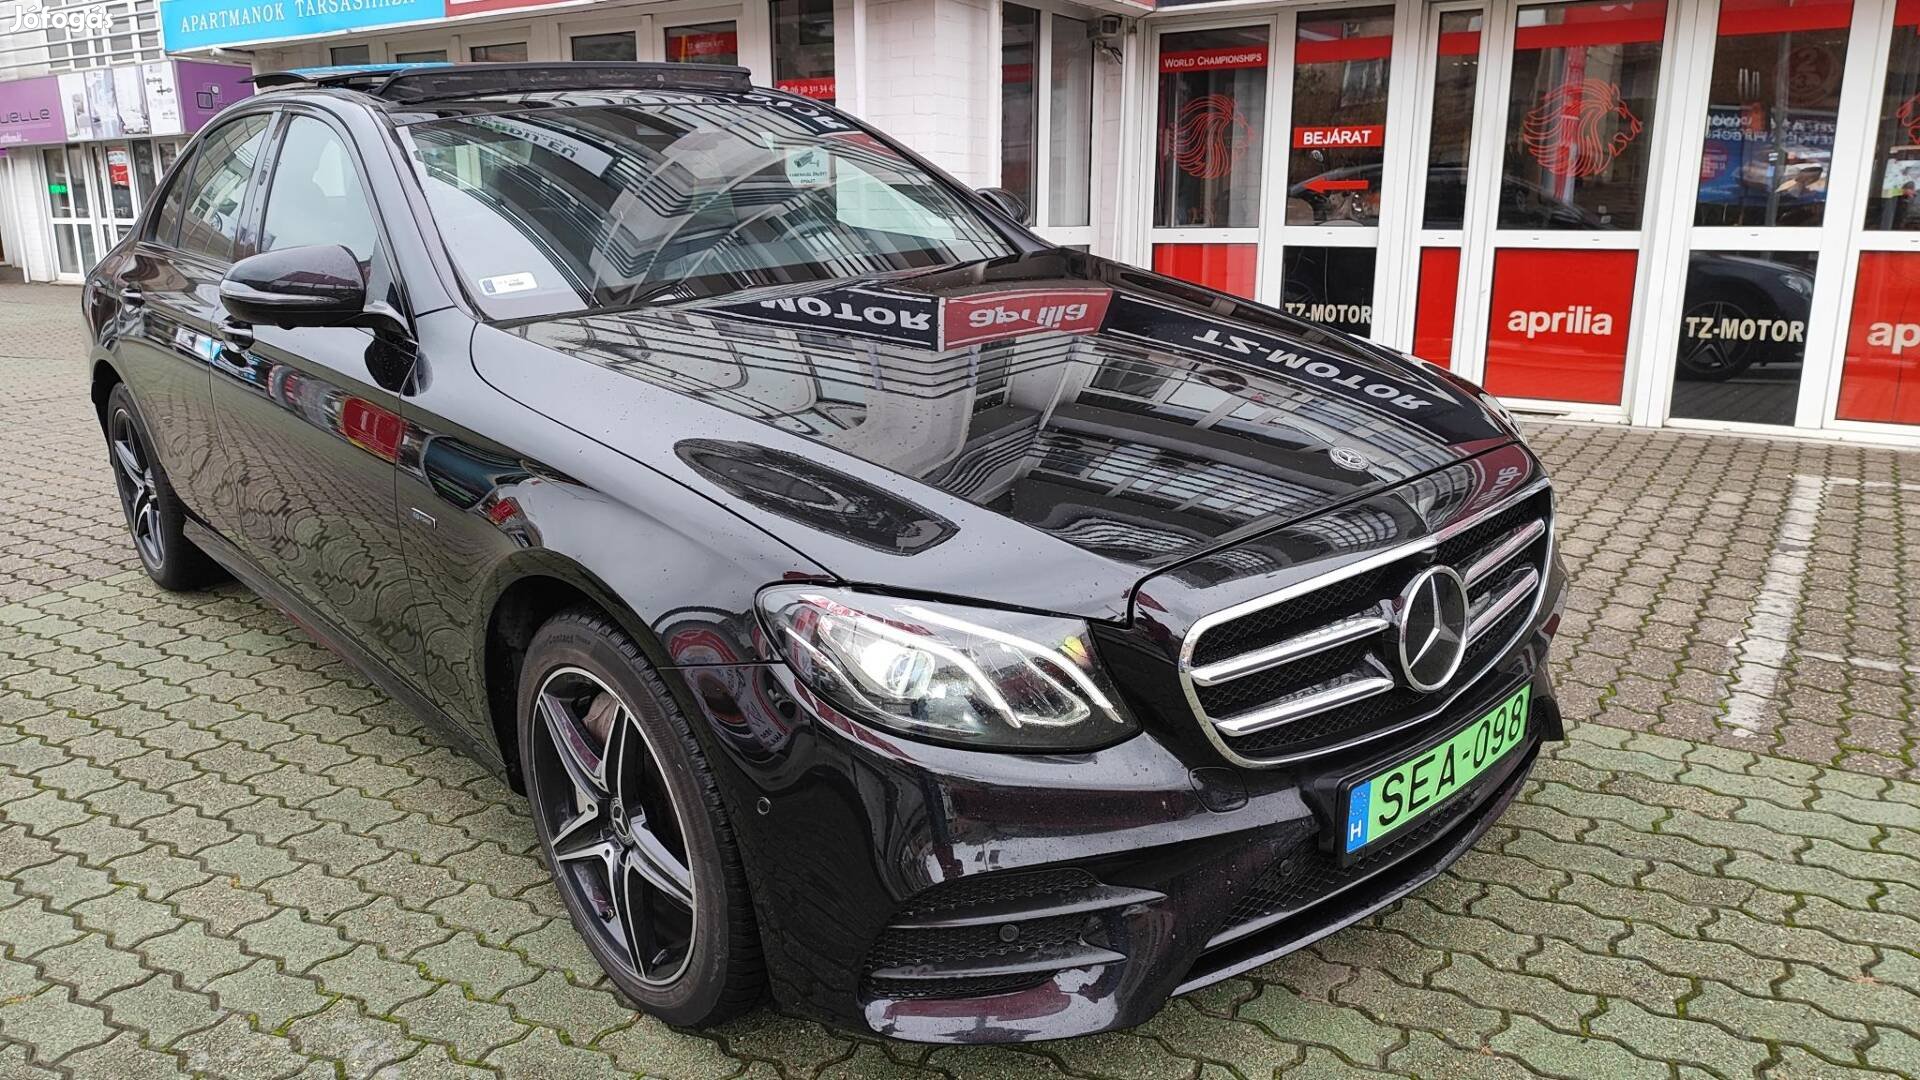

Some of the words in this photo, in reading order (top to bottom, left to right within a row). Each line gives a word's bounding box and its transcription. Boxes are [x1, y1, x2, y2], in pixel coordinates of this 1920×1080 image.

[181, 2, 285, 33] APARTMANOK
[1303, 128, 1372, 145] BEJÁRAT
[1285, 302, 1372, 324] TZ-MOTOR
[1507, 305, 1613, 339] aprilia
[1685, 317, 1805, 343] TZ-MOTOR
[1866, 321, 1920, 354] ap
[1379, 694, 1524, 826] SEA-098
[1350, 820, 1361, 841] H
